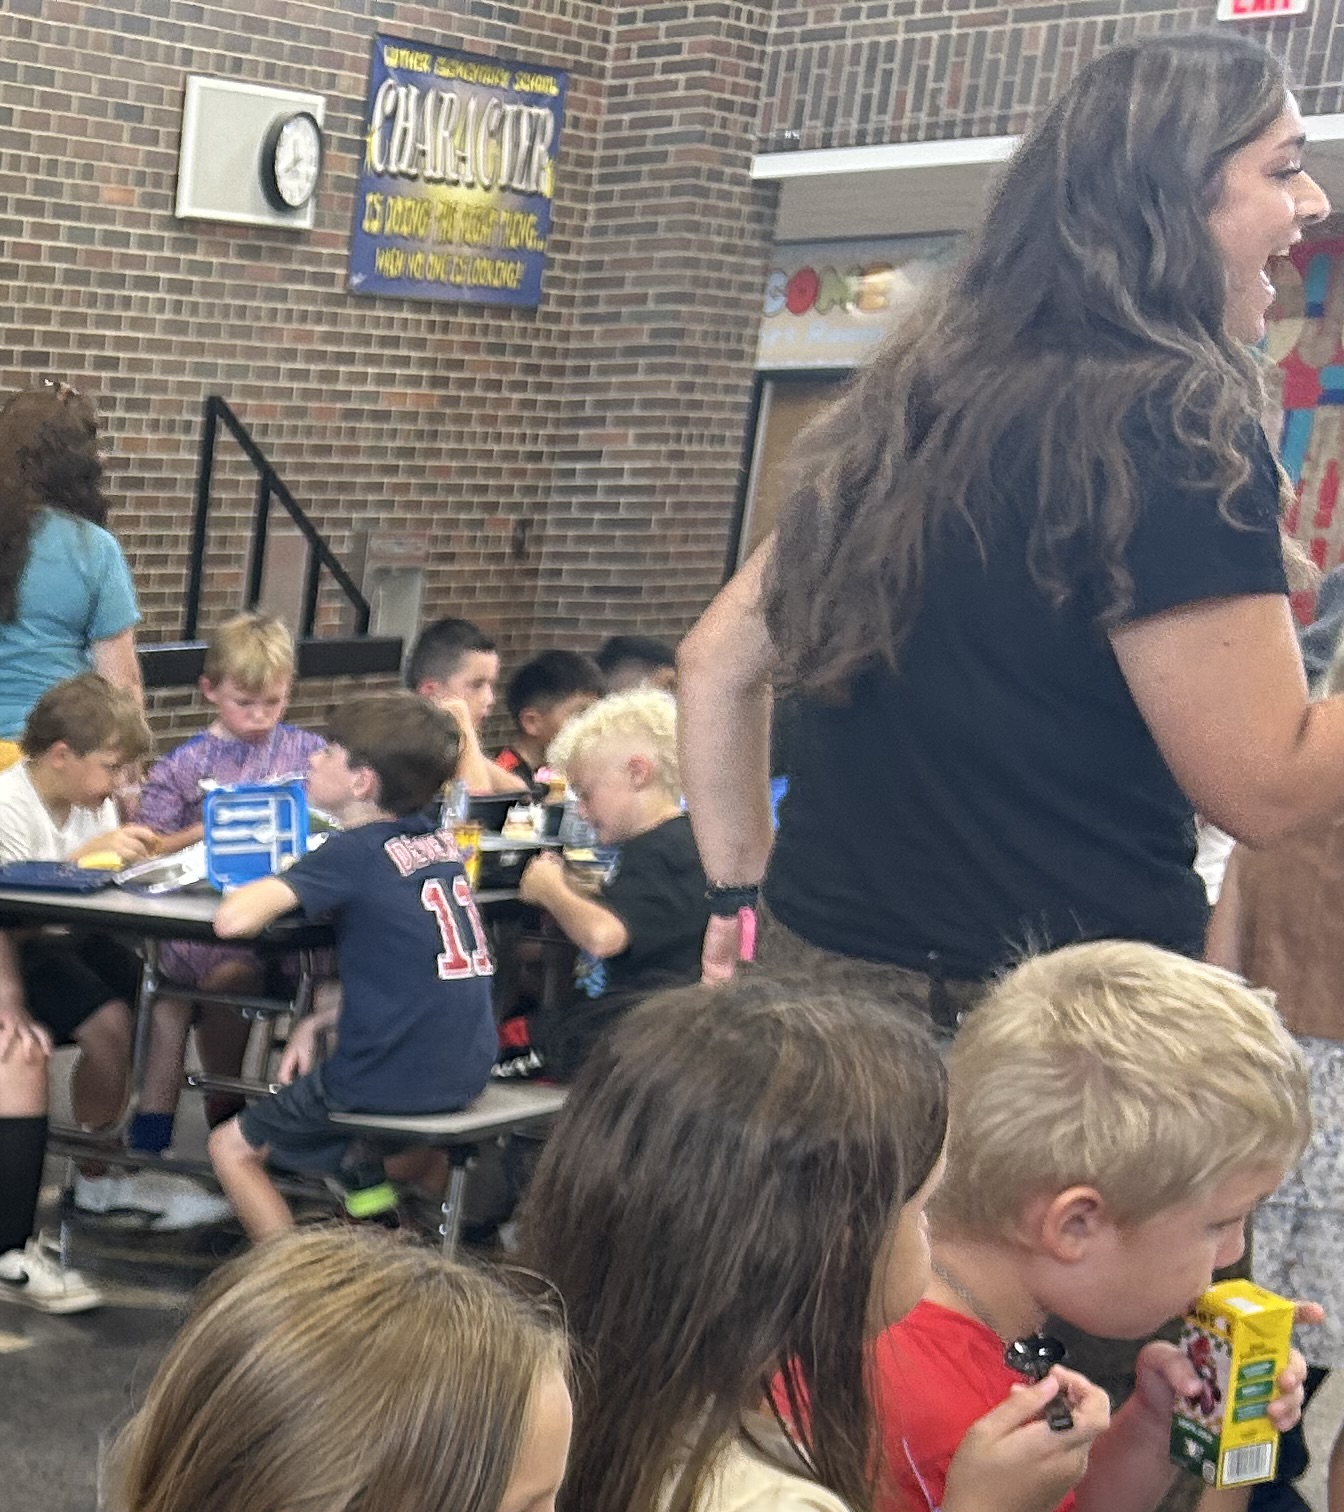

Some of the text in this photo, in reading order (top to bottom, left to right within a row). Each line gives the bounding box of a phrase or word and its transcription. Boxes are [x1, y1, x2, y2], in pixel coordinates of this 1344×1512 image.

[514, 71, 559, 97] SCHOOL
[372, 78, 555, 195] CHARACTER
[363, 192, 384, 234] IS
[384, 195, 432, 239] DOING
[421, 875, 496, 980] 11
